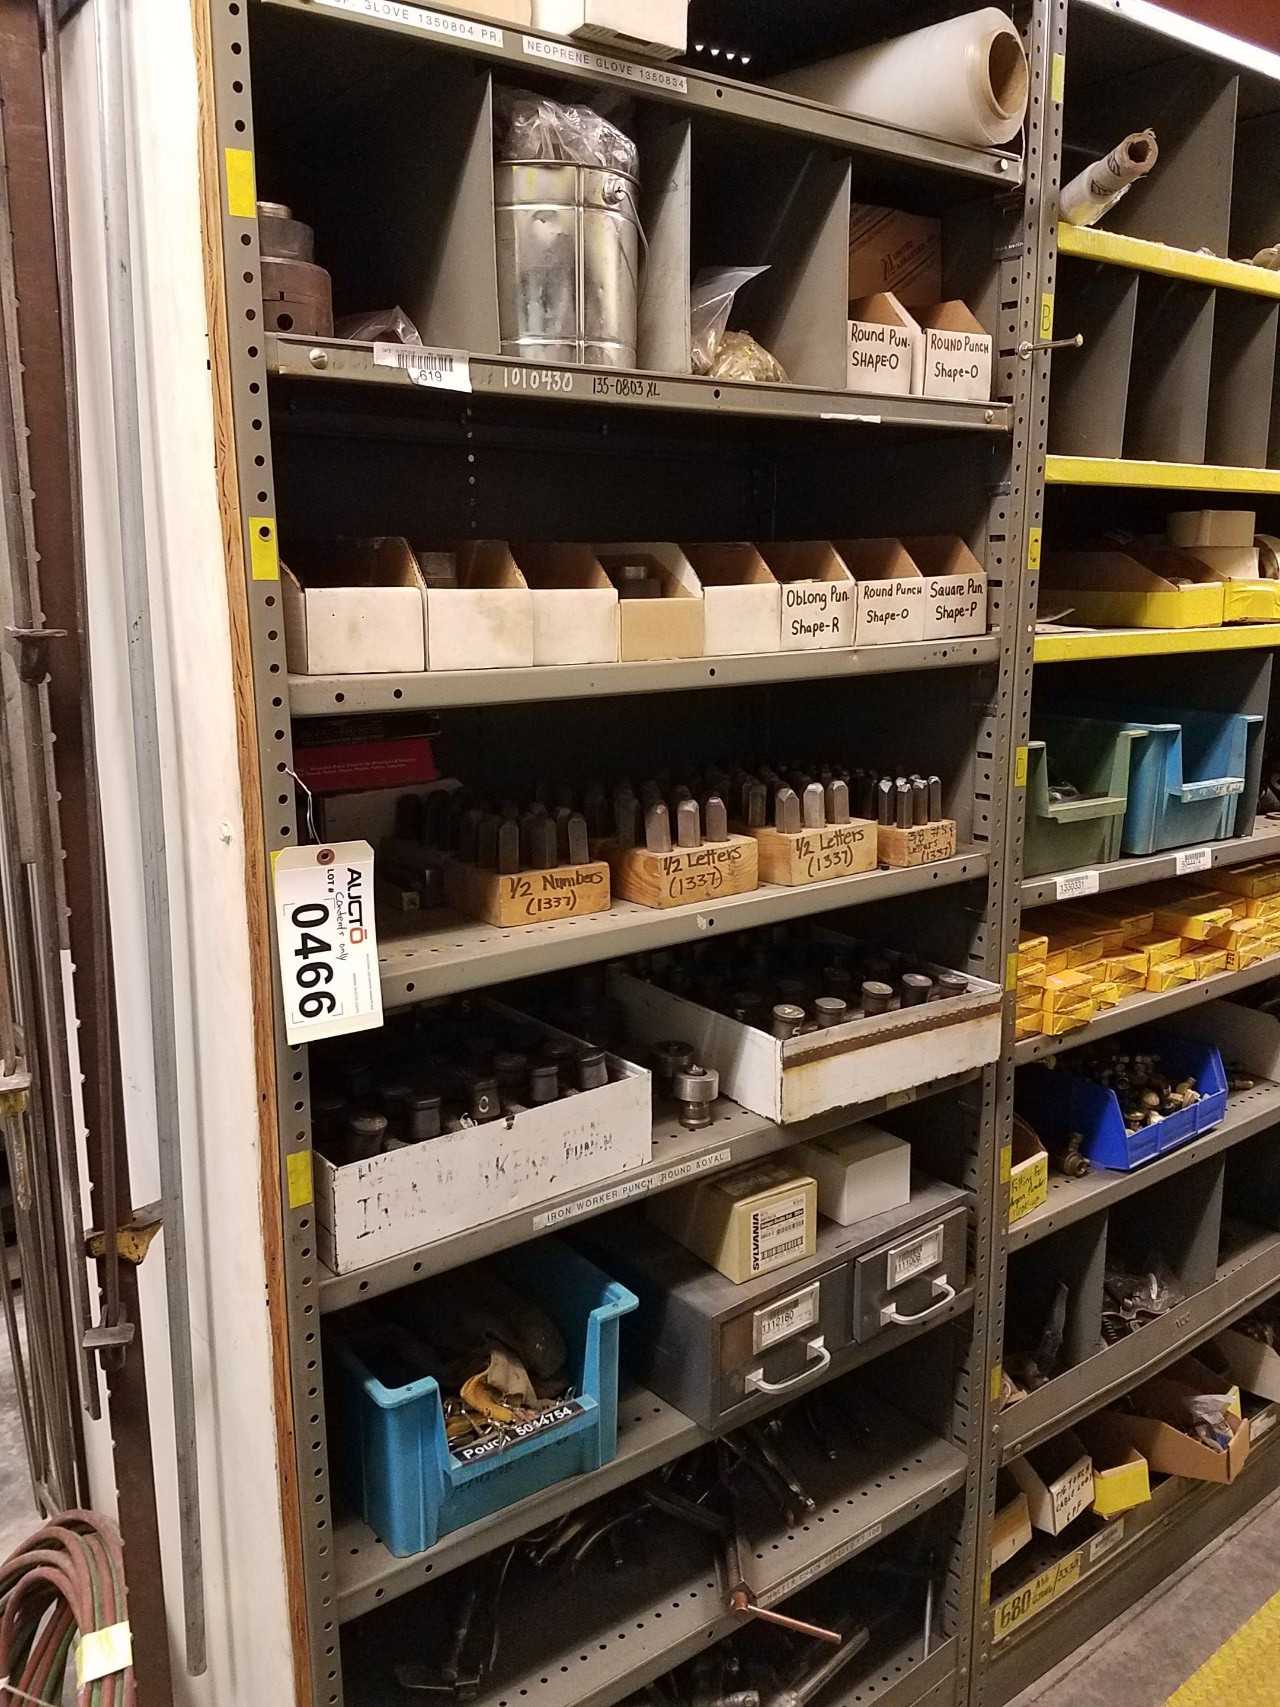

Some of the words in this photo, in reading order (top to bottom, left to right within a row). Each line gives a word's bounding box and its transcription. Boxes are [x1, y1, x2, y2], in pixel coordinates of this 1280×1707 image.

[418, 13, 474, 35] 1350804
[527, 40, 590, 64] NEOPRENE
[595, 60, 633, 75] GLOVE
[639, 69, 684, 88] 1350834
[851, 322, 885, 343] Round
[503, 366, 574, 391] 1010430
[934, 361, 979, 382] Shape-O
[592, 376, 644, 397] 135-0803
[646, 381, 661, 397] XL
[863, 583, 893, 600] Round
[929, 581, 965, 598] Square
[866, 608, 909, 625] Shape-O
[935, 601, 978, 623] Shape-P
[791, 616, 840, 637] Shape-R
[795, 836, 815, 859] 1/2
[819, 828, 864, 851] Letters
[662, 855, 684, 876] 1/2
[687, 846, 743, 868] Letters
[807, 844, 854, 878] (1337)
[327, 868, 335, 886] LOT
[509, 876, 533, 899] 1/2
[542, 870, 604, 891] Numbers
[668, 865, 724, 899] (1337)
[525, 889, 578, 916] (1337)
[292, 902, 337, 1019] 0466
[546, 1207, 573, 1223] IRON
[576, 1190, 619, 1212] WORKER
[622, 1178, 654, 1196] PUNCH
[660, 1164, 692, 1182] ROUND
[752, 1213, 760, 1271] SYLVANIA
